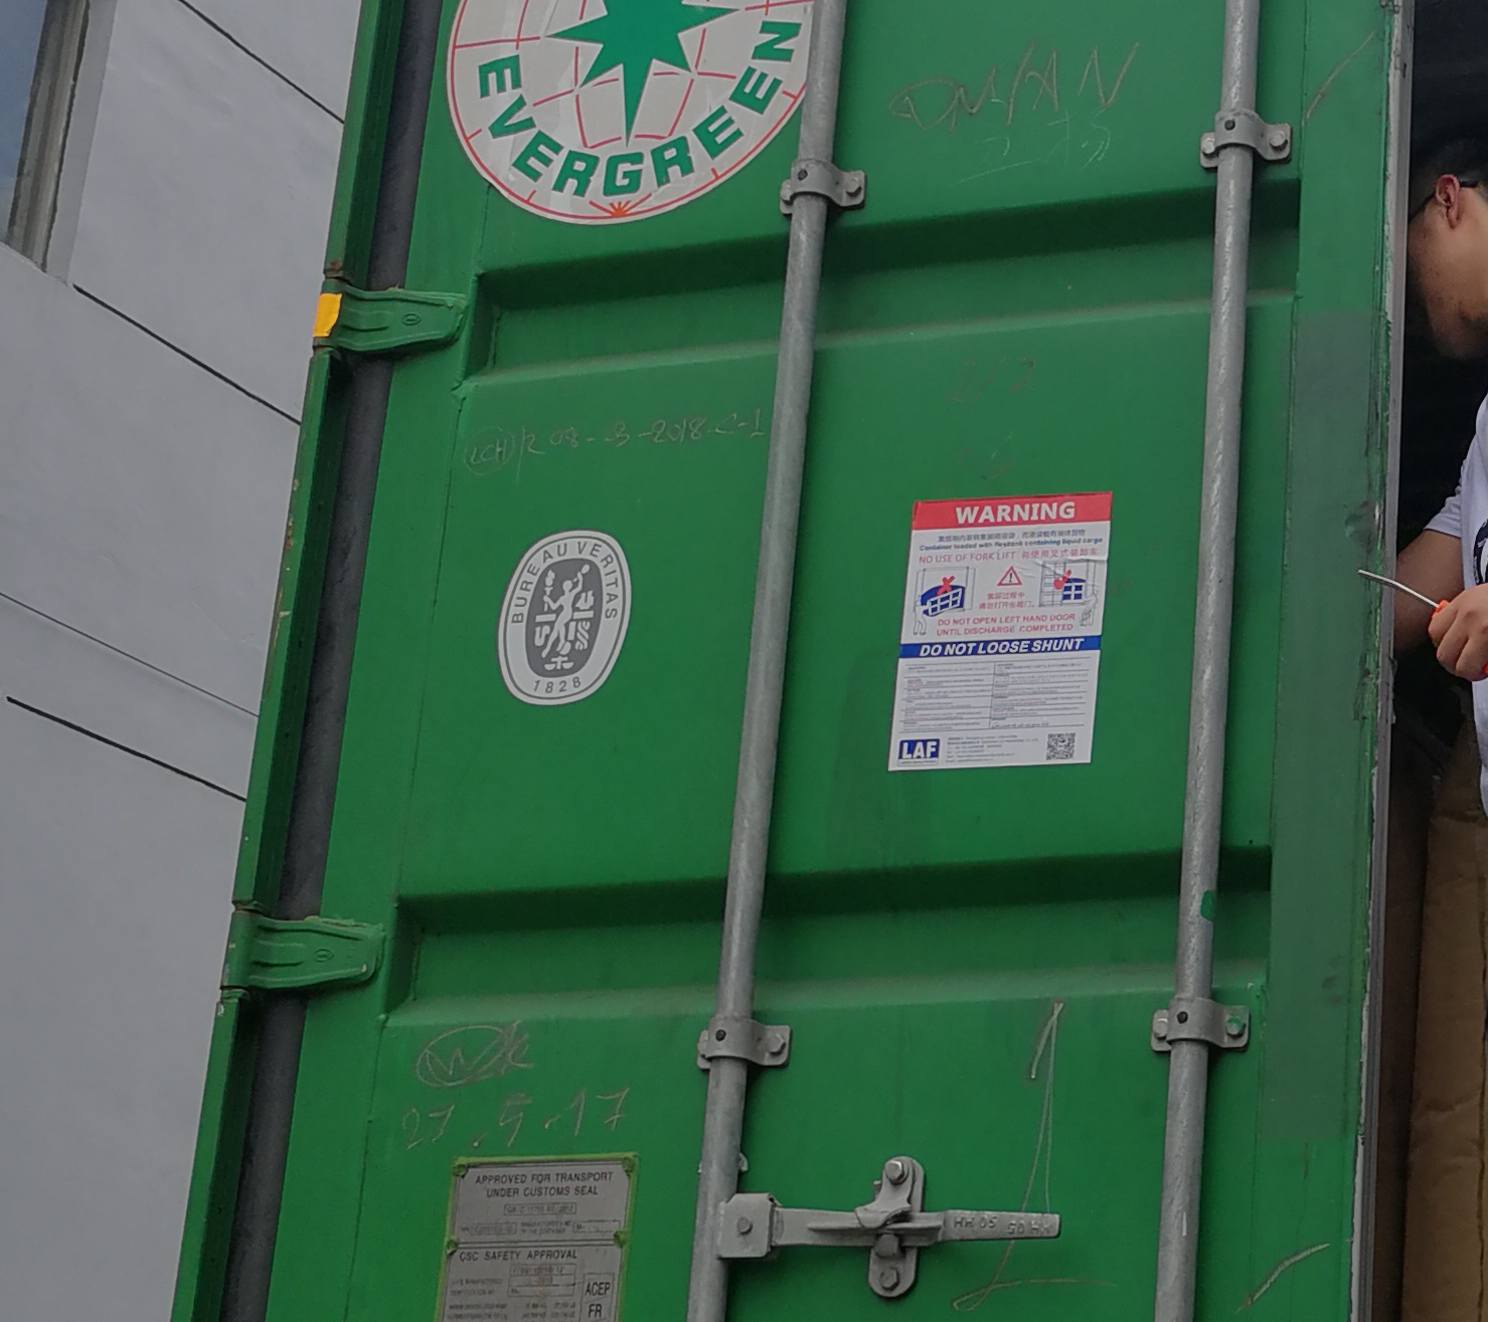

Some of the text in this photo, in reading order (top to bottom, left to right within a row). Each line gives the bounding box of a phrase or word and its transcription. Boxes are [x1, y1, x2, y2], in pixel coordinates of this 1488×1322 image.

[478, 20, 802, 197] EVERGREEN
[955, 501, 1076, 525] WARNING
[919, 550, 1016, 564] NO USE OF FORK LIFT
[511, 541, 619, 624] BUREAU VERITAS
[938, 613, 1076, 626] DO NOT OPEN LEFT HAND DOOR
[937, 623, 1074, 637] UNTIL DISCHARGE COMPLETED
[920, 638, 1085, 657] DO NOT LOOSE SHUNT
[533, 675, 581, 694] 1828
[901, 740, 938, 759] LAF
[475, 1171, 615, 1184] APPROVED FOR TRANSPORT
[486, 1185, 599, 1198] UNDER CUSTOMS SEAL
[459, 1249, 578, 1262] CSC SAFETY APPROVAL
[585, 1281, 611, 1296] ACEP
[588, 1303, 603, 1319] FR
